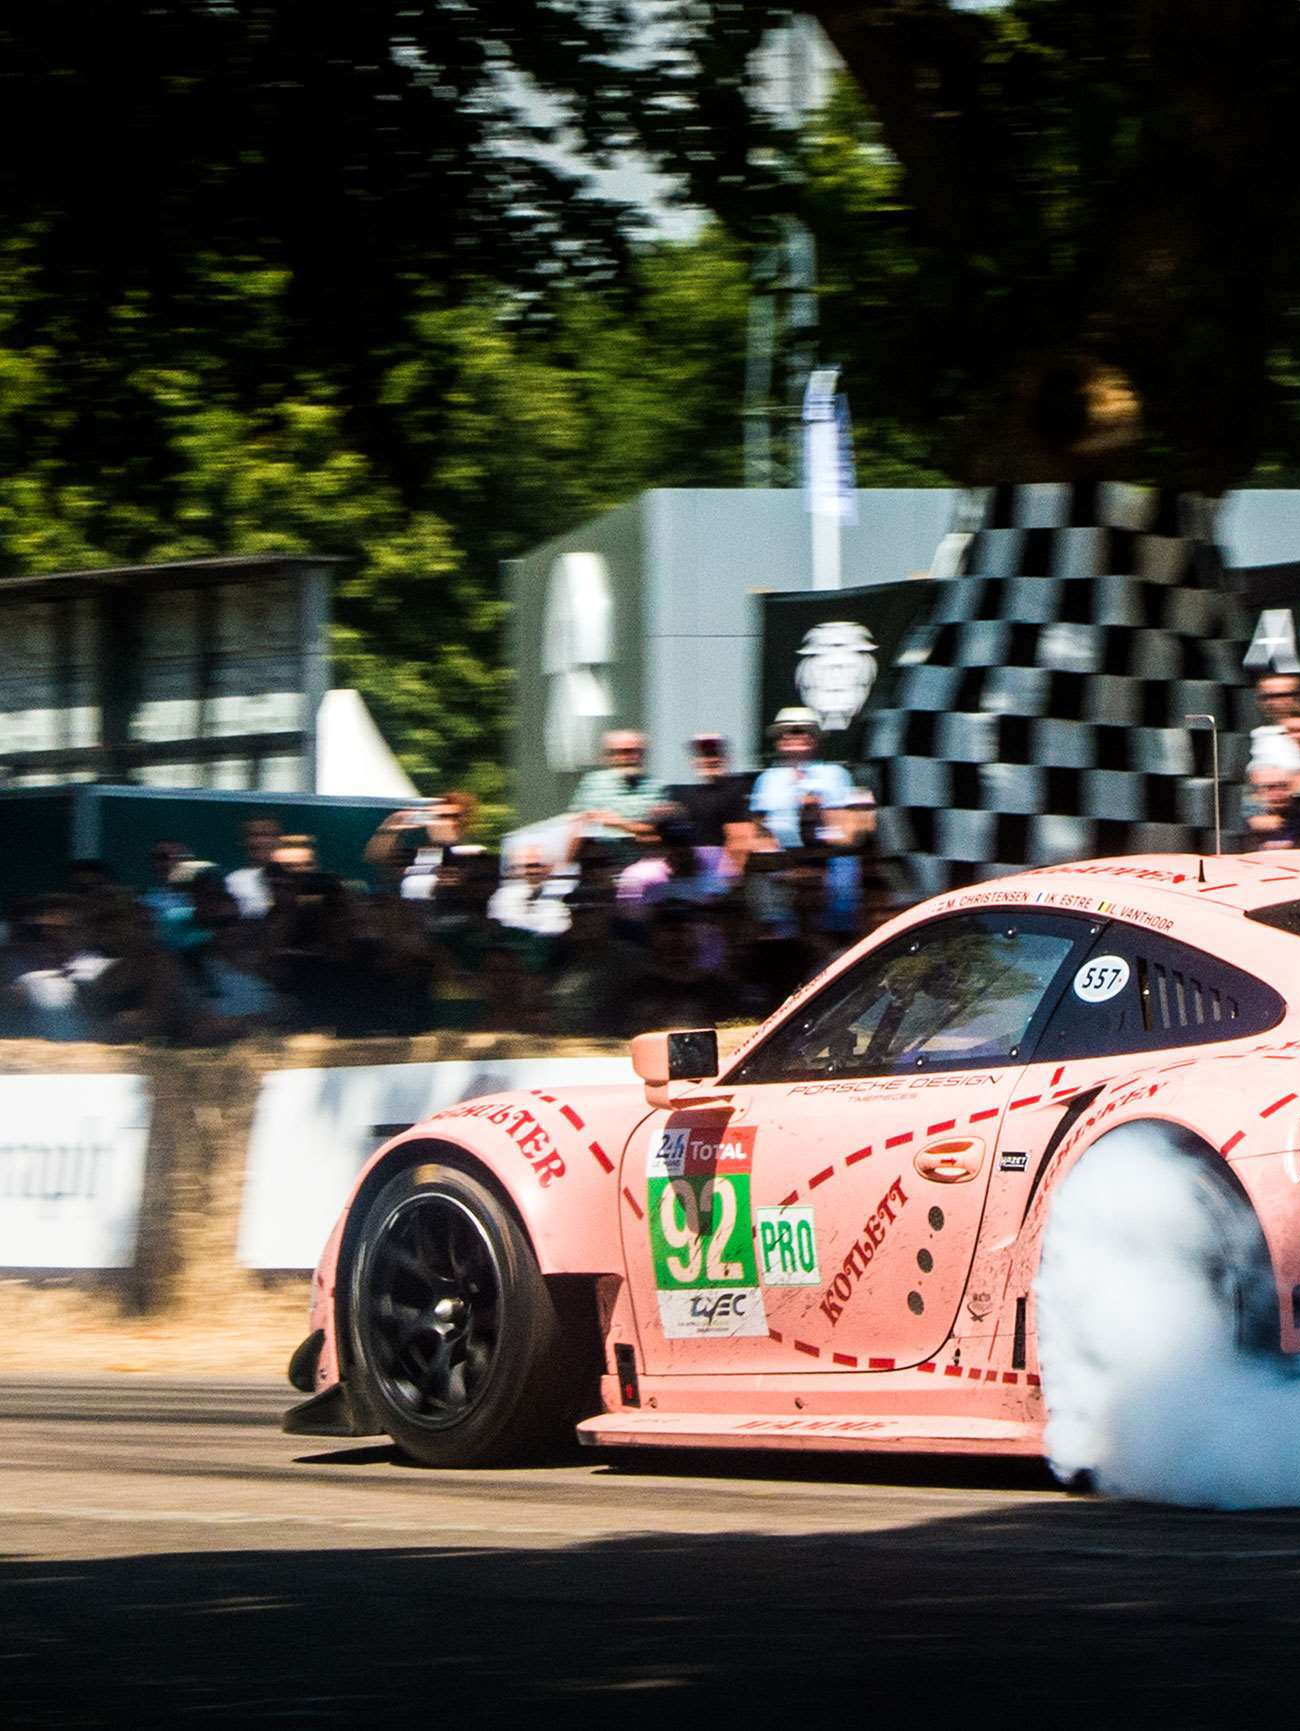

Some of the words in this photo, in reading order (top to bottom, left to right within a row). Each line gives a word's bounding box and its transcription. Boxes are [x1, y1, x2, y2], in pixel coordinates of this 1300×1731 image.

[1060, 894, 1093, 910] ESTRE
[1120, 906, 1174, 931] VANTHOOR
[1082, 967, 1122, 990] 557
[786, 1078, 906, 1097] PORSCHE
[909, 1074, 1004, 1089] DESIGN
[689, 1141, 747, 1161] TOTAL
[660, 1176, 744, 1283] 92
[761, 1219, 815, 1274] PRO
[688, 1293, 747, 1326] WEC
